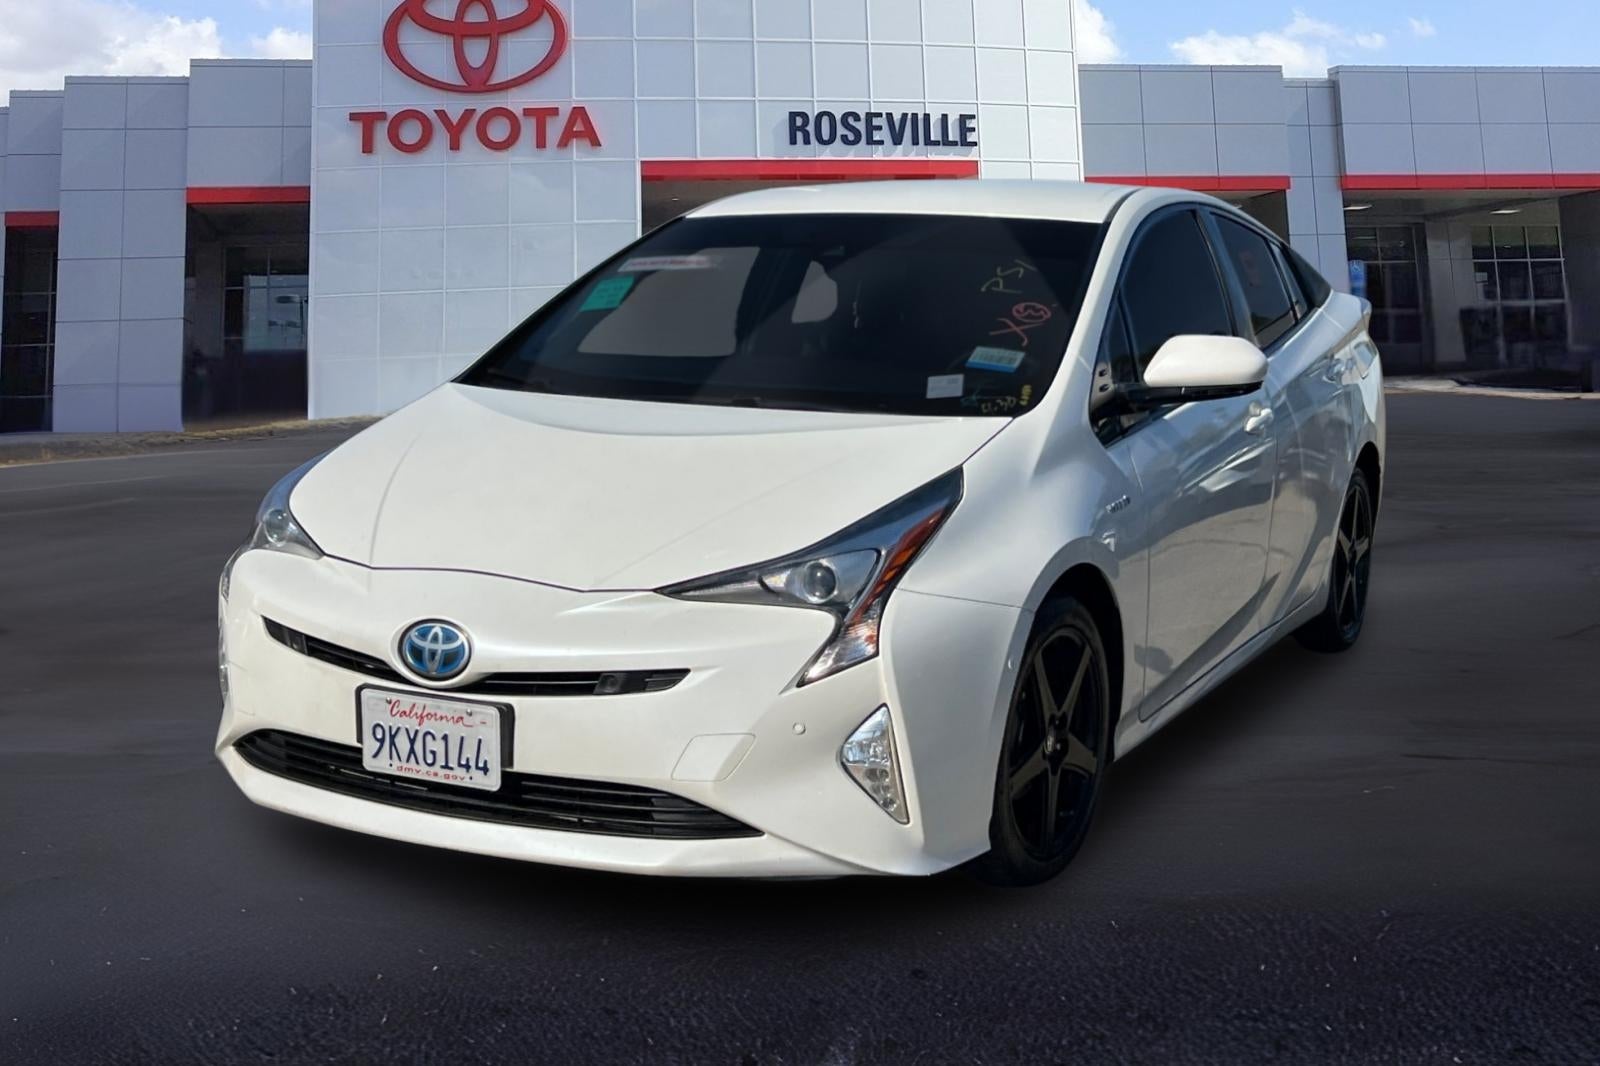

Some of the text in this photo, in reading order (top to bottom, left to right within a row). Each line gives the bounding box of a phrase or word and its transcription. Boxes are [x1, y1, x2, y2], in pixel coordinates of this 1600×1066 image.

[349, 106, 602, 154] TOYOTA
[788, 110, 978, 147] ROSEVILLE
[389, 699, 474, 727] California
[371, 722, 490, 776] 9KXG144
[396, 764, 466, 781] dmv.ca.gov
